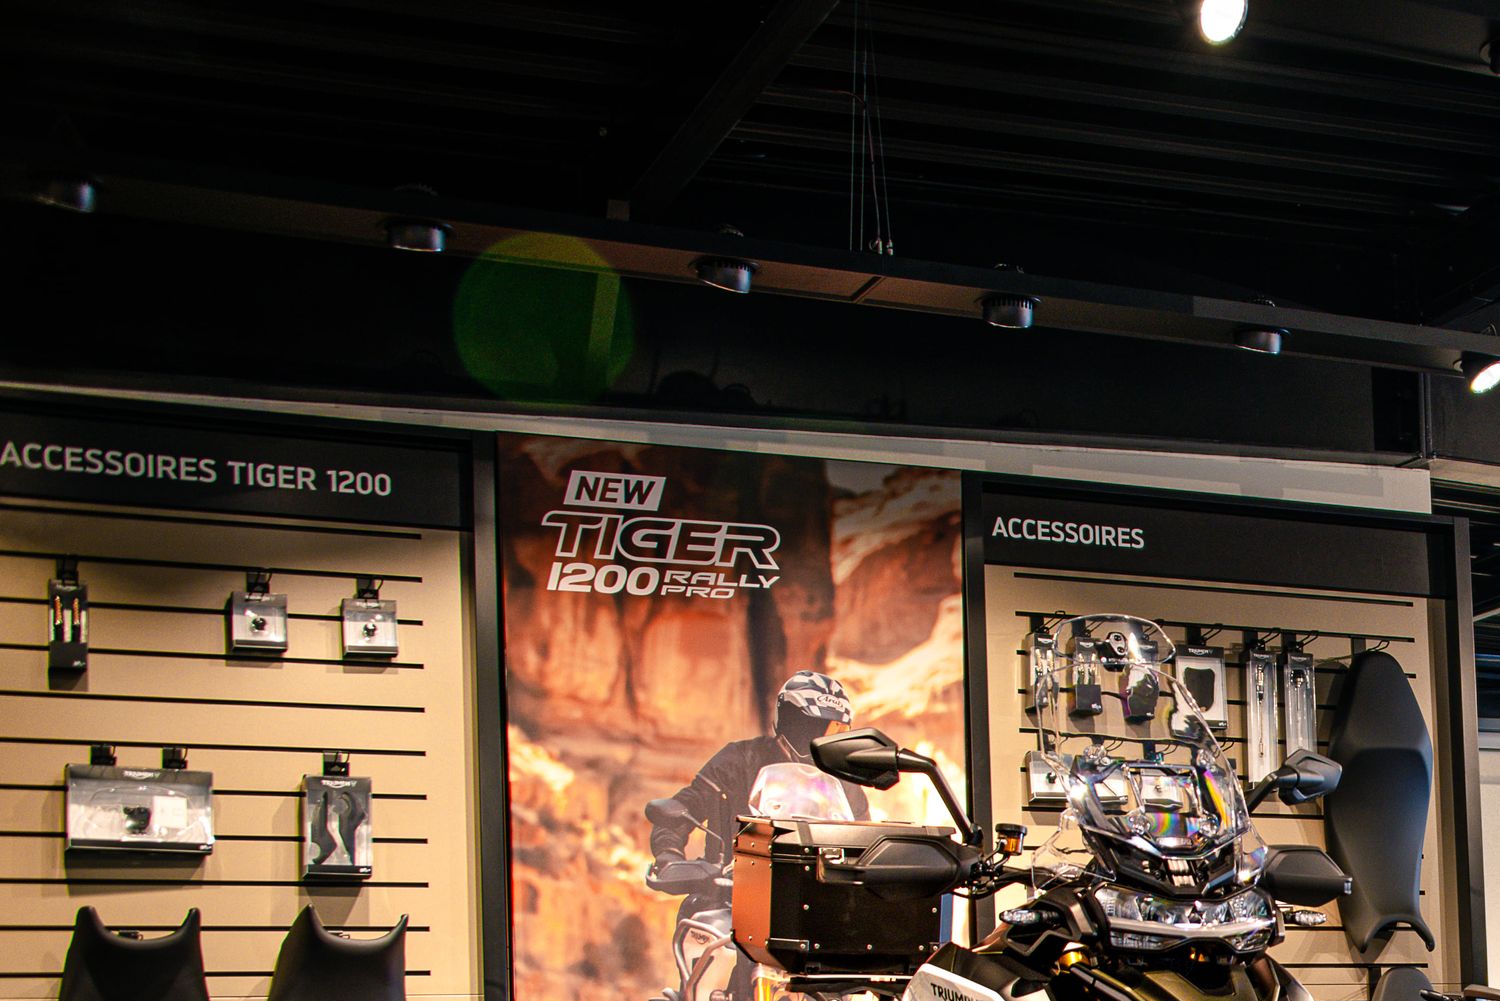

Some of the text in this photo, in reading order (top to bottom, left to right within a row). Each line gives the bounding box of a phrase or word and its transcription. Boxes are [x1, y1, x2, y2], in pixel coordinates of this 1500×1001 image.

[0, 441, 392, 496] ACCESSOIRES TIGER 1200
[574, 475, 657, 505] NEW
[541, 509, 782, 570] TIGER
[991, 516, 1146, 549] ACCESSOIRES
[546, 561, 781, 596] 1200 RALLY
[660, 585, 736, 599] PRO
